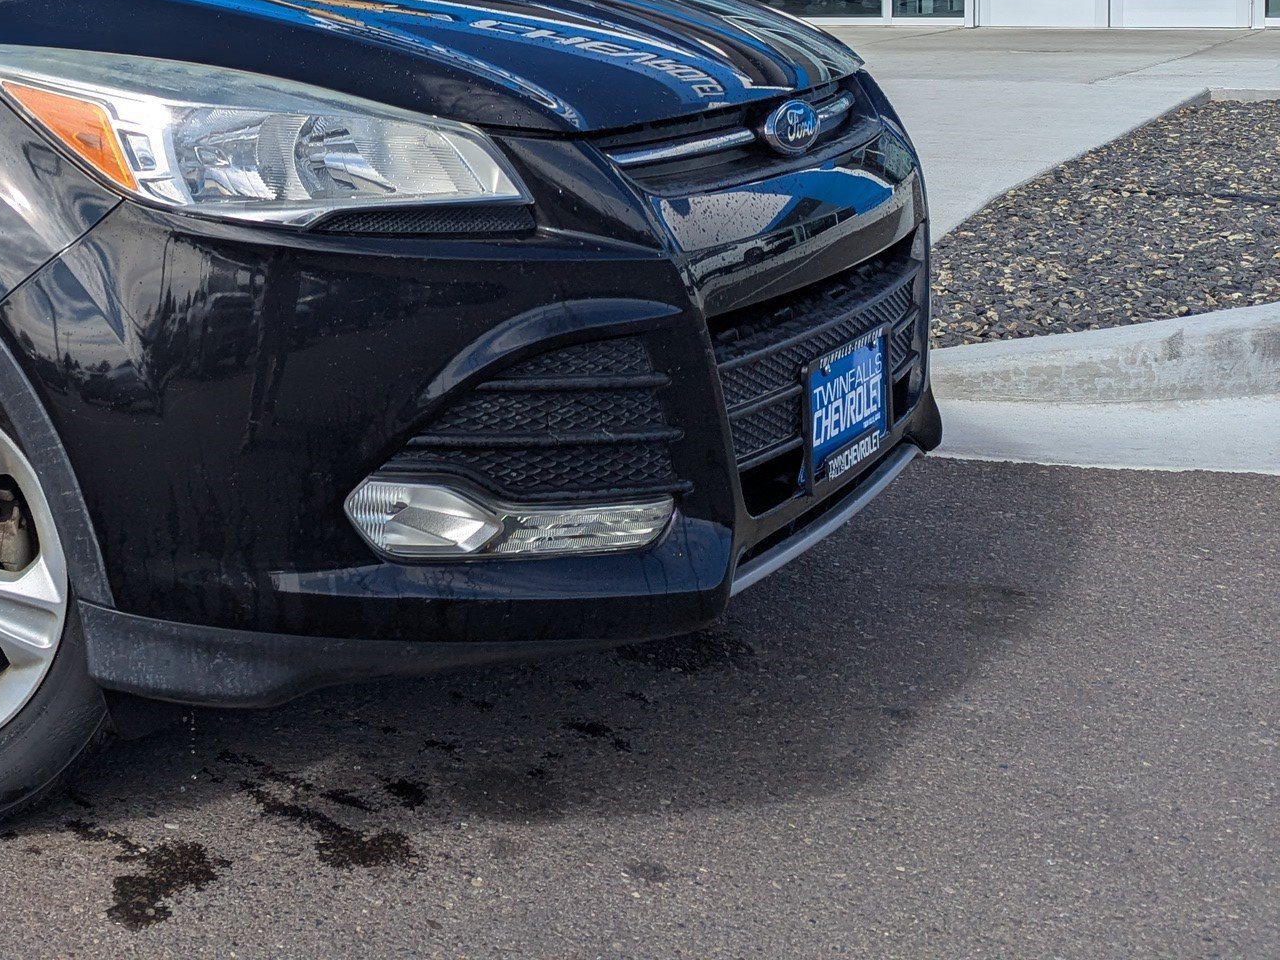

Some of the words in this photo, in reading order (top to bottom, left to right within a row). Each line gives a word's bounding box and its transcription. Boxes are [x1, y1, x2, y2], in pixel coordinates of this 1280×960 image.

[786, 107, 815, 142] Ford
[813, 373, 883, 448] CHEVROLET
[844, 429, 880, 470] CHEVROLET
